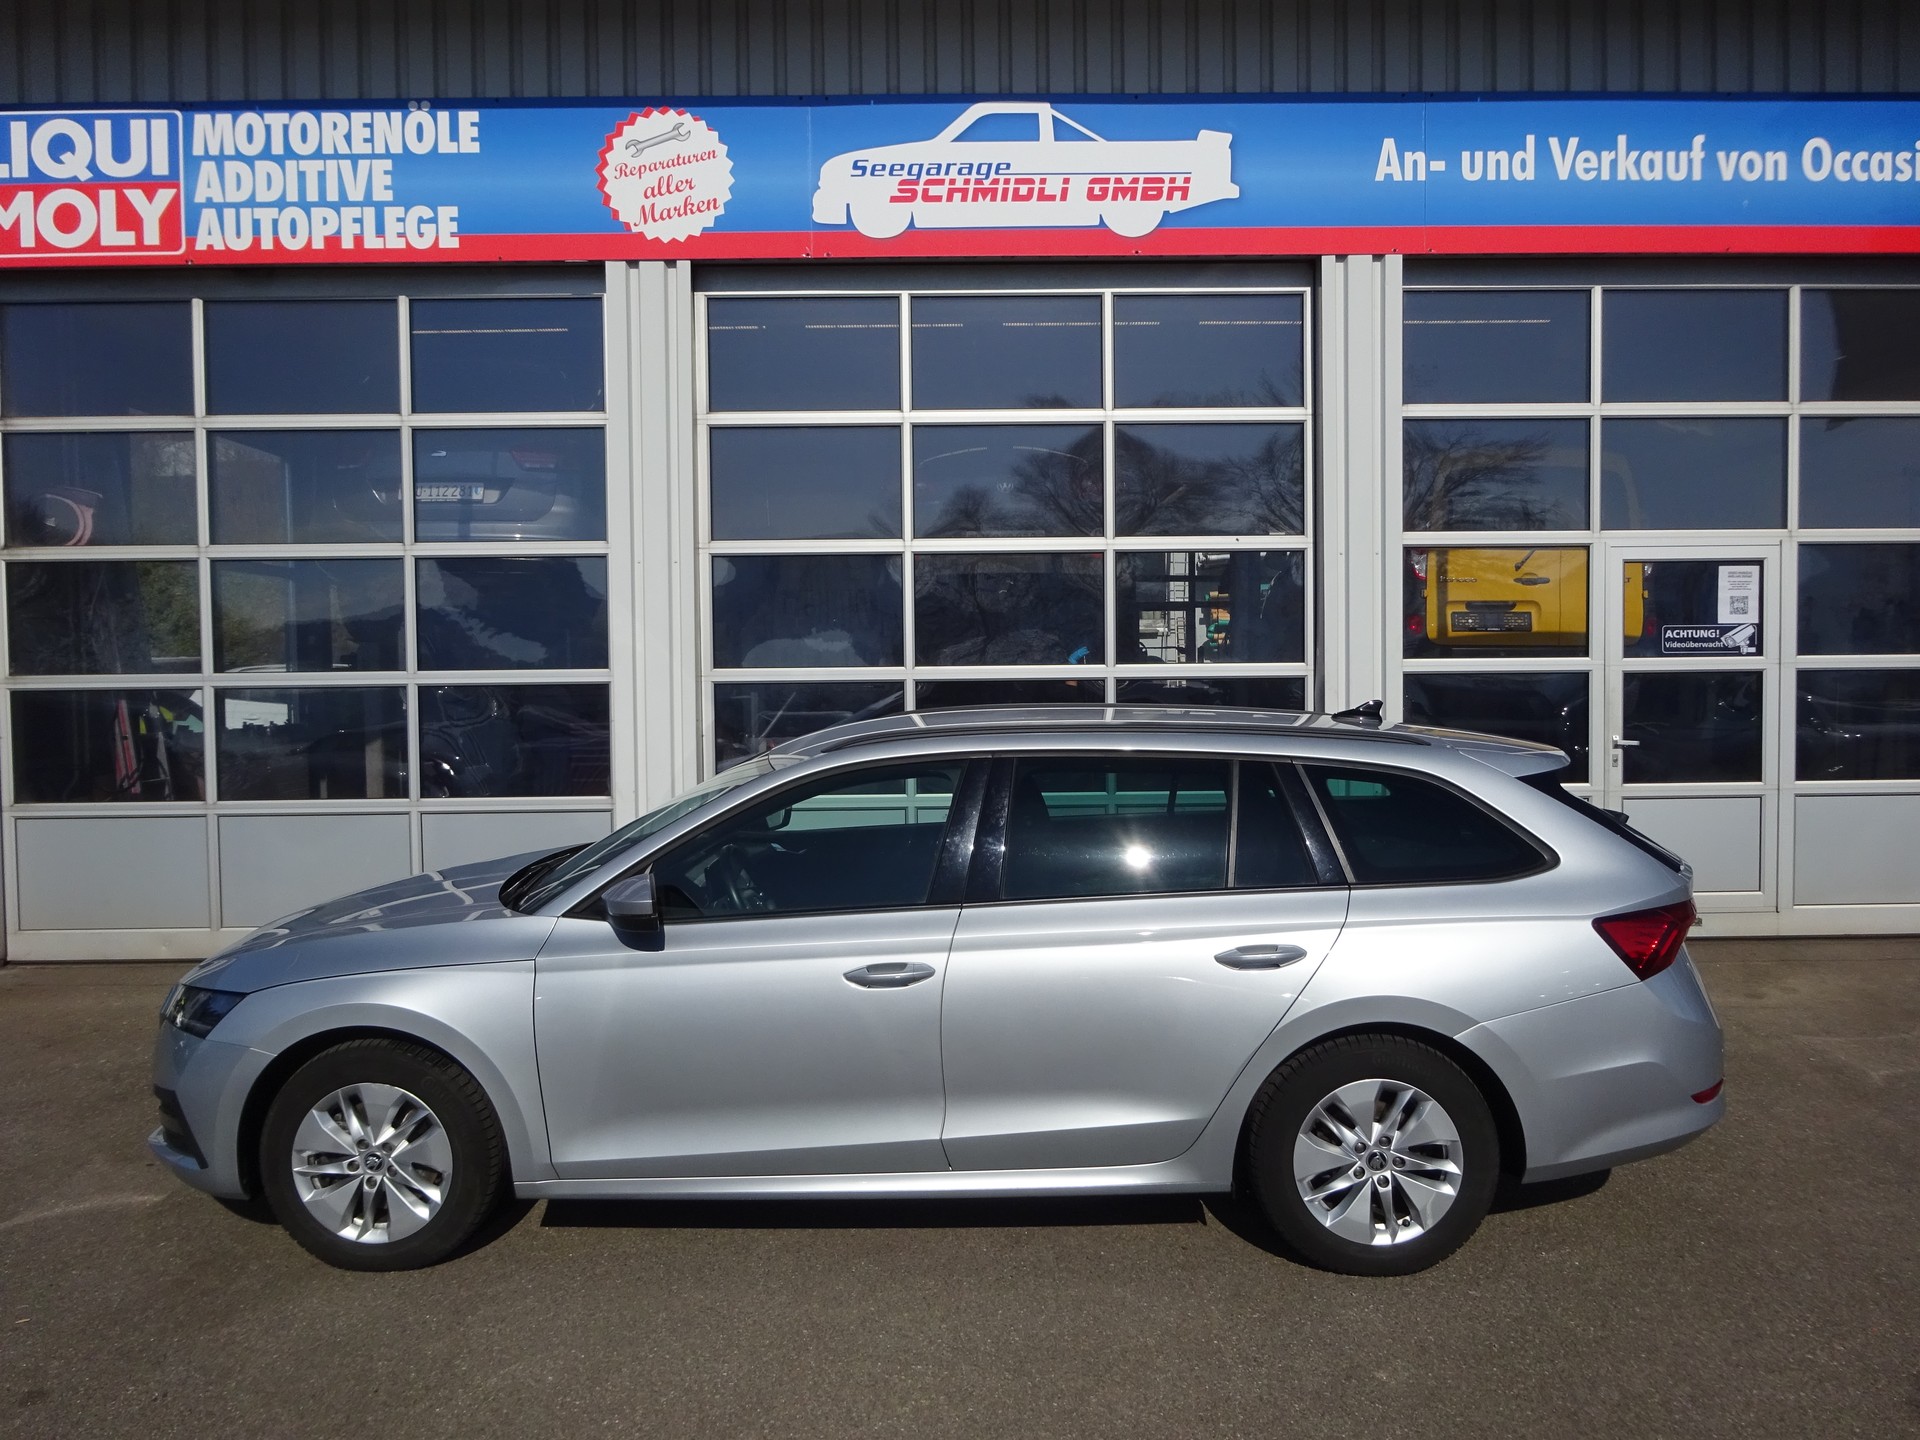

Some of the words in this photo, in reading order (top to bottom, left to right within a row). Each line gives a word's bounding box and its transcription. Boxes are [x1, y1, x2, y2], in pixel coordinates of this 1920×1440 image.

[192, 101, 481, 156] MOTORENÖLE
[0, 118, 170, 182] IQUI
[614, 149, 718, 180] Reparaturen
[1374, 137, 1446, 182] An-
[1461, 134, 1536, 182] und
[1548, 134, 1706, 182] Verkauf
[1716, 149, 1789, 182] von
[1801, 137, 1920, 183] Occasi
[194, 159, 394, 203] ADDITIVE
[643, 173, 696, 200] aller
[850, 159, 1012, 181] Seegarage
[1086, 176, 1192, 202] GMBH
[0, 188, 178, 249] MOLY
[194, 206, 460, 251] AUTOPFLEGE
[633, 195, 720, 227] Marken
[1665, 629, 1720, 638] ACHTUNG!
